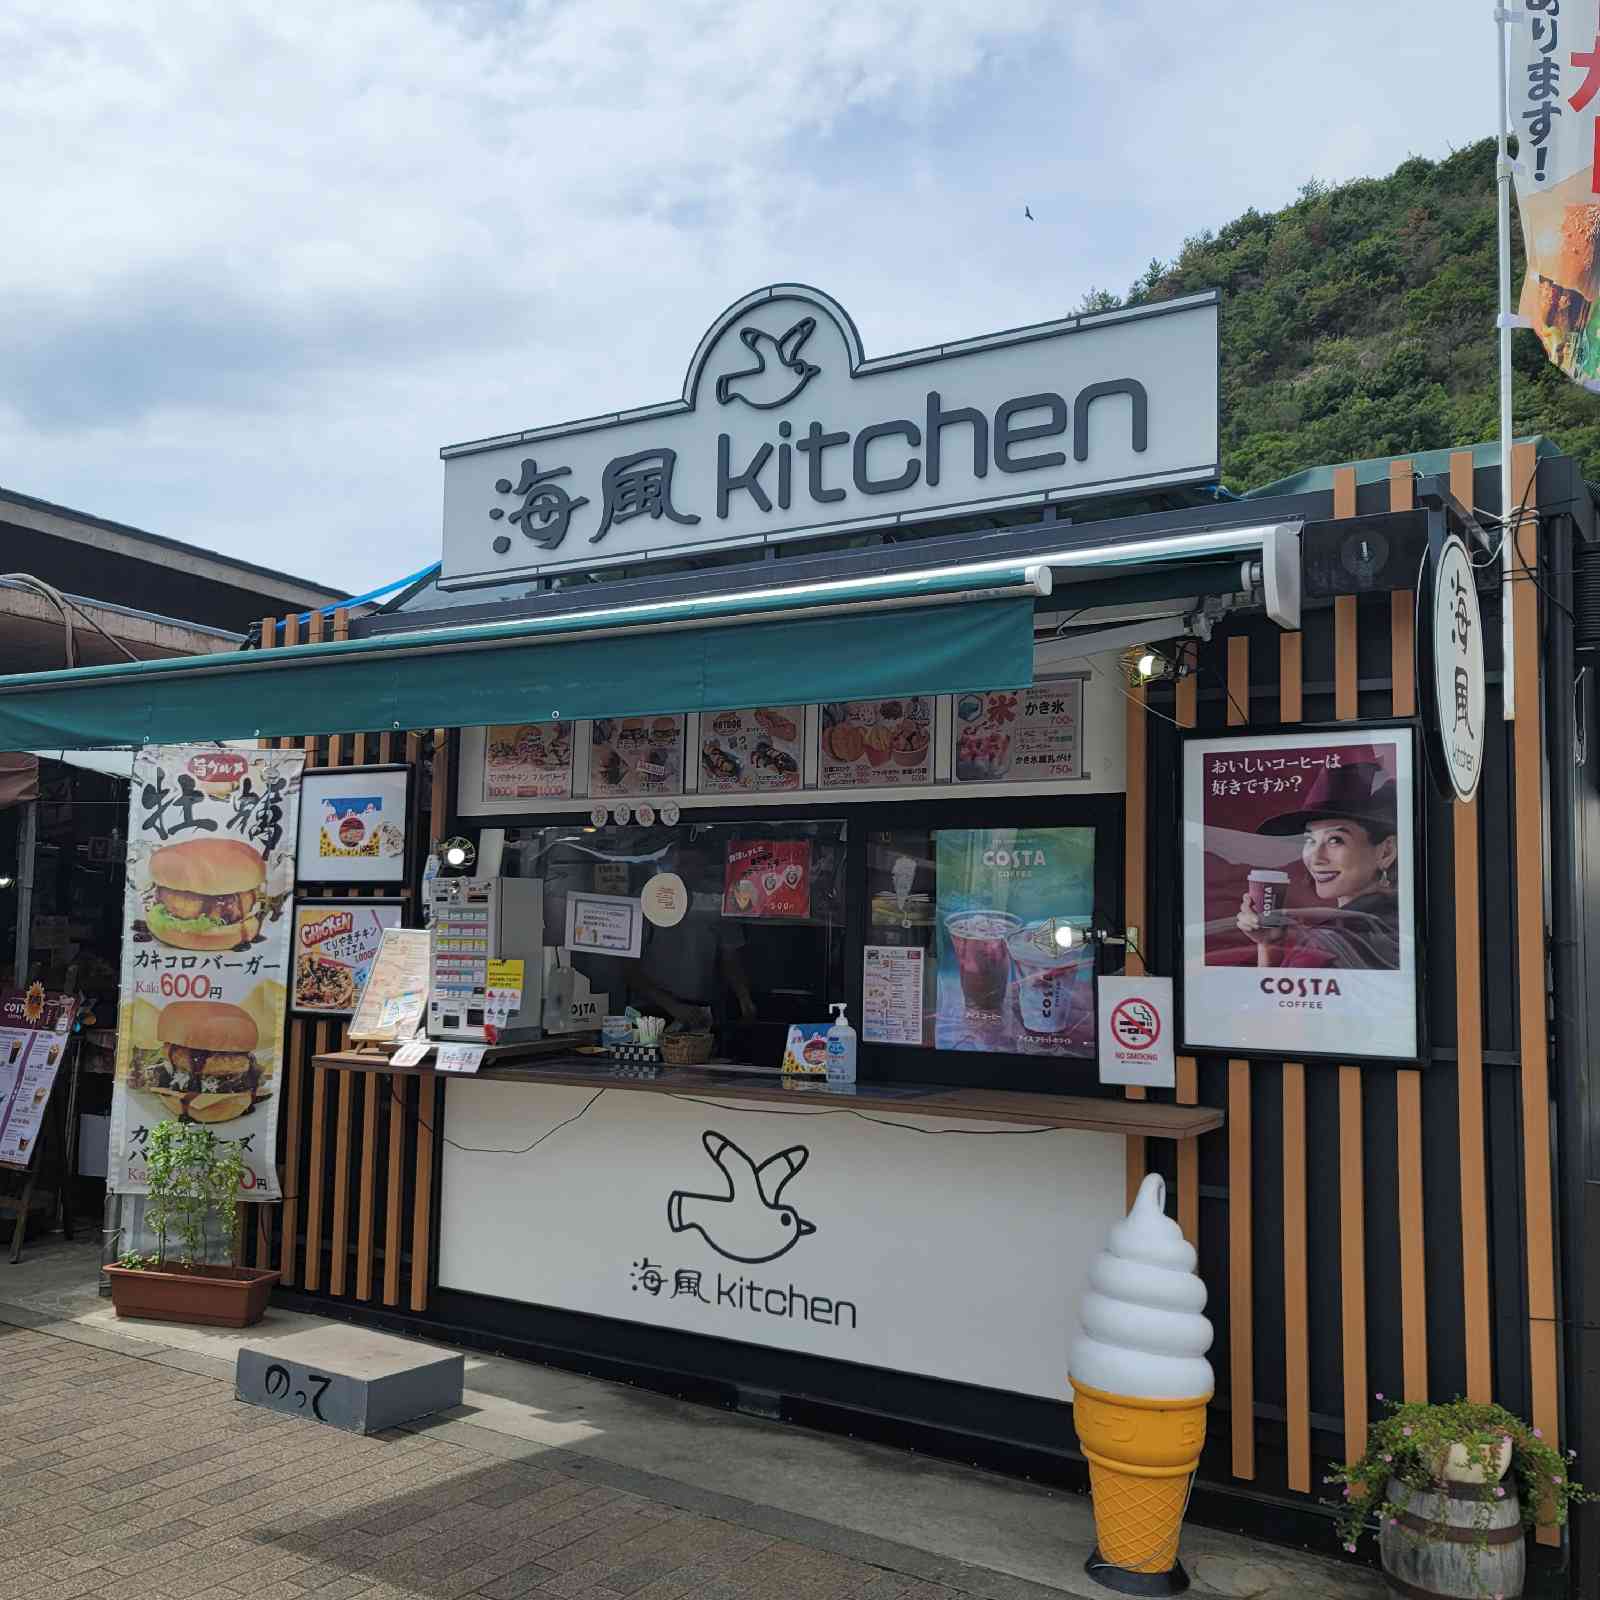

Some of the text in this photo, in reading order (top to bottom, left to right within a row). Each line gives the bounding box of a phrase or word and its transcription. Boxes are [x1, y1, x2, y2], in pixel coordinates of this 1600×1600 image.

[488, 377, 1148, 554] 海風 kitchen
[1211, 752, 1342, 775] おいしいコーヒーは
[1211, 775, 1303, 796] 好きですか?
[982, 849, 1047, 867] COSTA
[301, 912, 352, 945] CHICKEN
[325, 926, 377, 952] てりやきチキン
[133, 950, 281, 975] カキコロバーガー
[334, 942, 365, 959] PIZZA
[160, 973, 222, 999] 600円
[1260, 977, 1341, 997] COSTA
[1279, 1000, 1323, 1010] COFFEE
[630, 1257, 857, 1329] 海風 kitchen
[264, 1364, 333, 1422] のって
